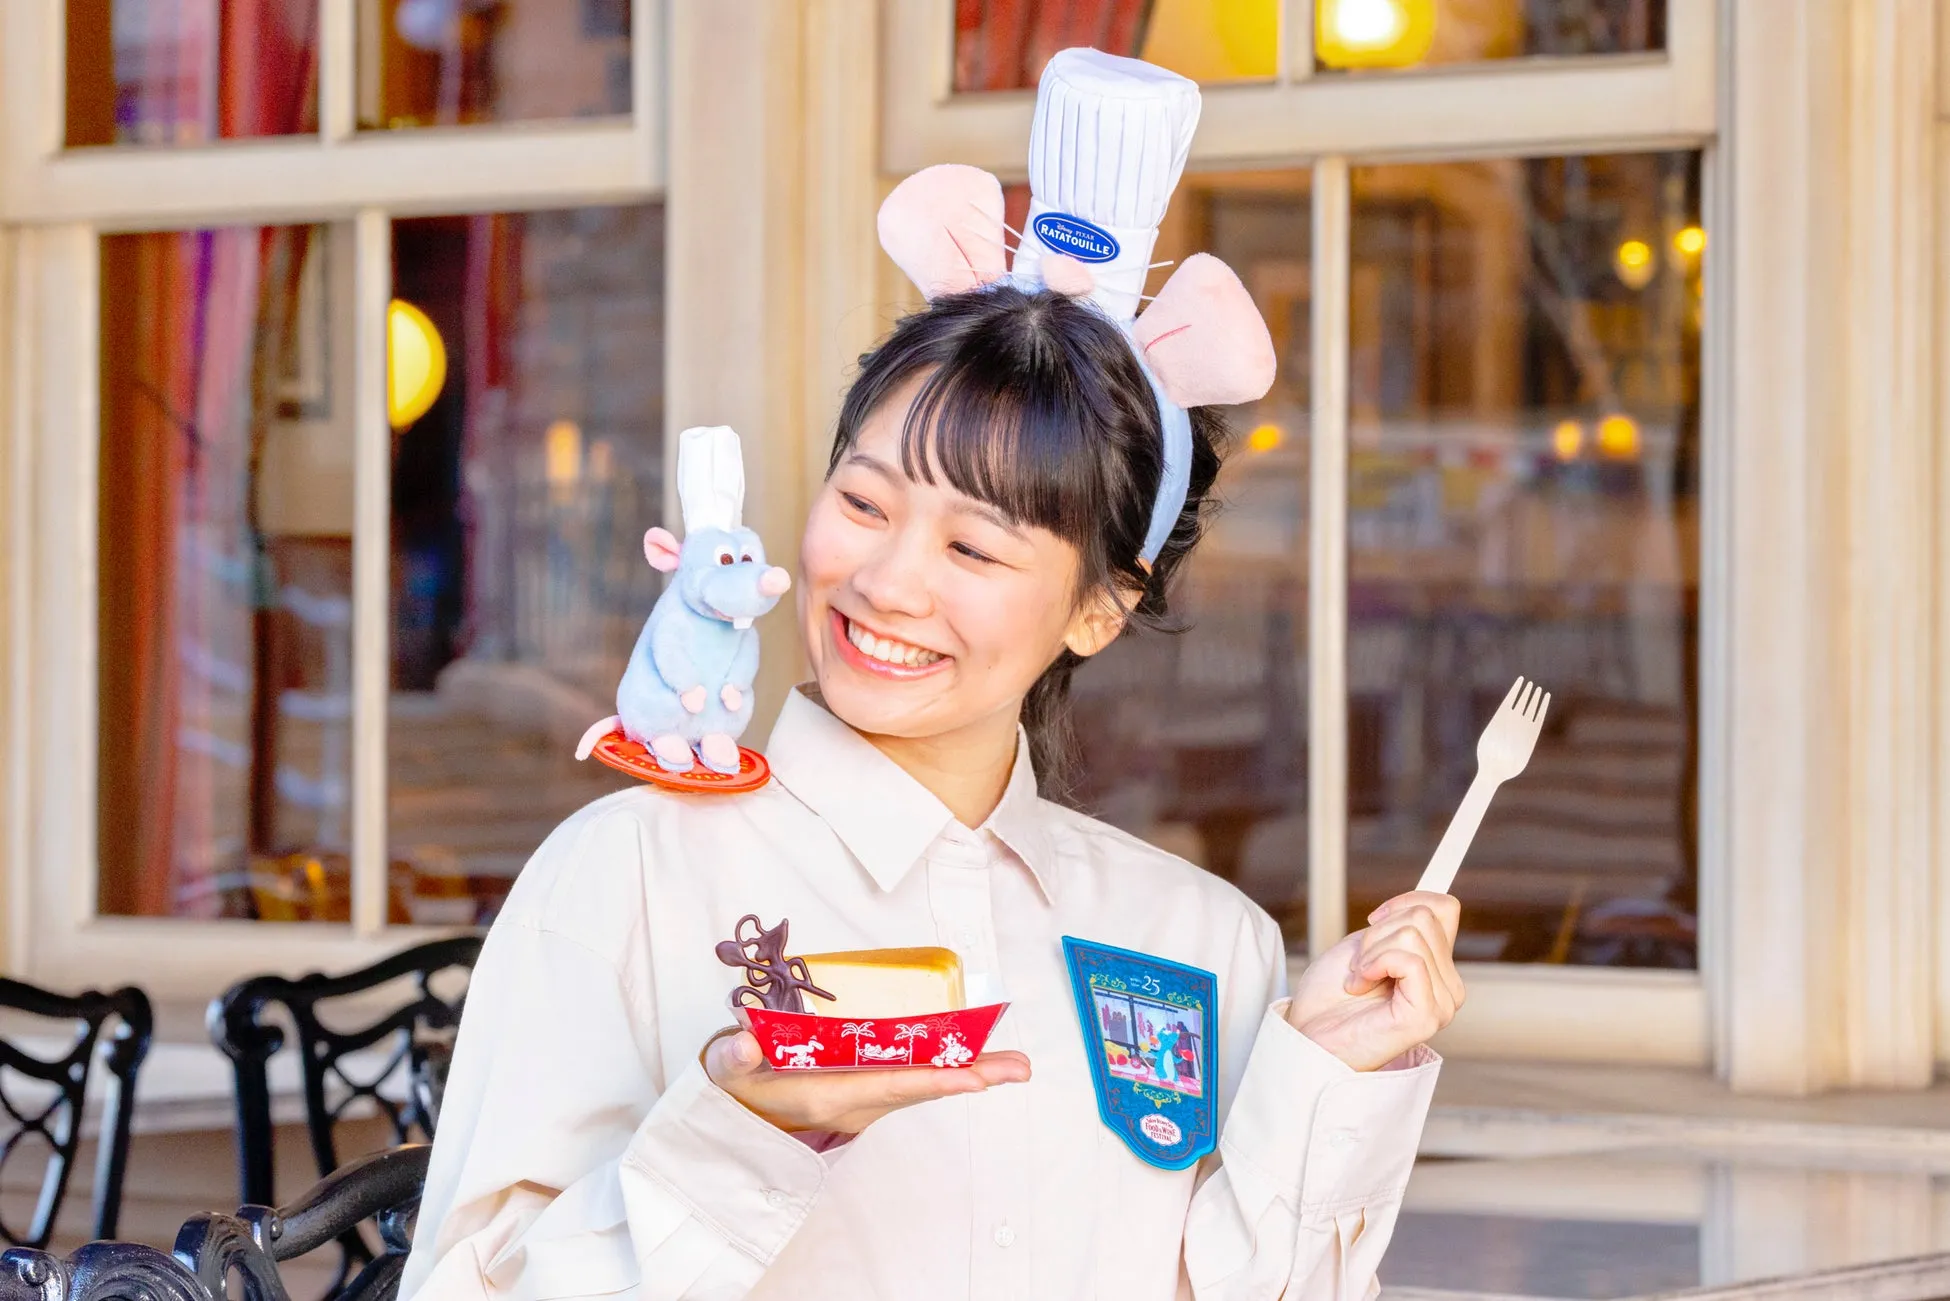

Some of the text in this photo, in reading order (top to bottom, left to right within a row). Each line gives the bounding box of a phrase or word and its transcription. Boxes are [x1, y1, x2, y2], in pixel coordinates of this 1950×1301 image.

[1041, 224, 1110, 255] RATATOUILLE
[1056, 222, 1095, 241] Disney PIXAR
[1141, 975, 1160, 995] 25
